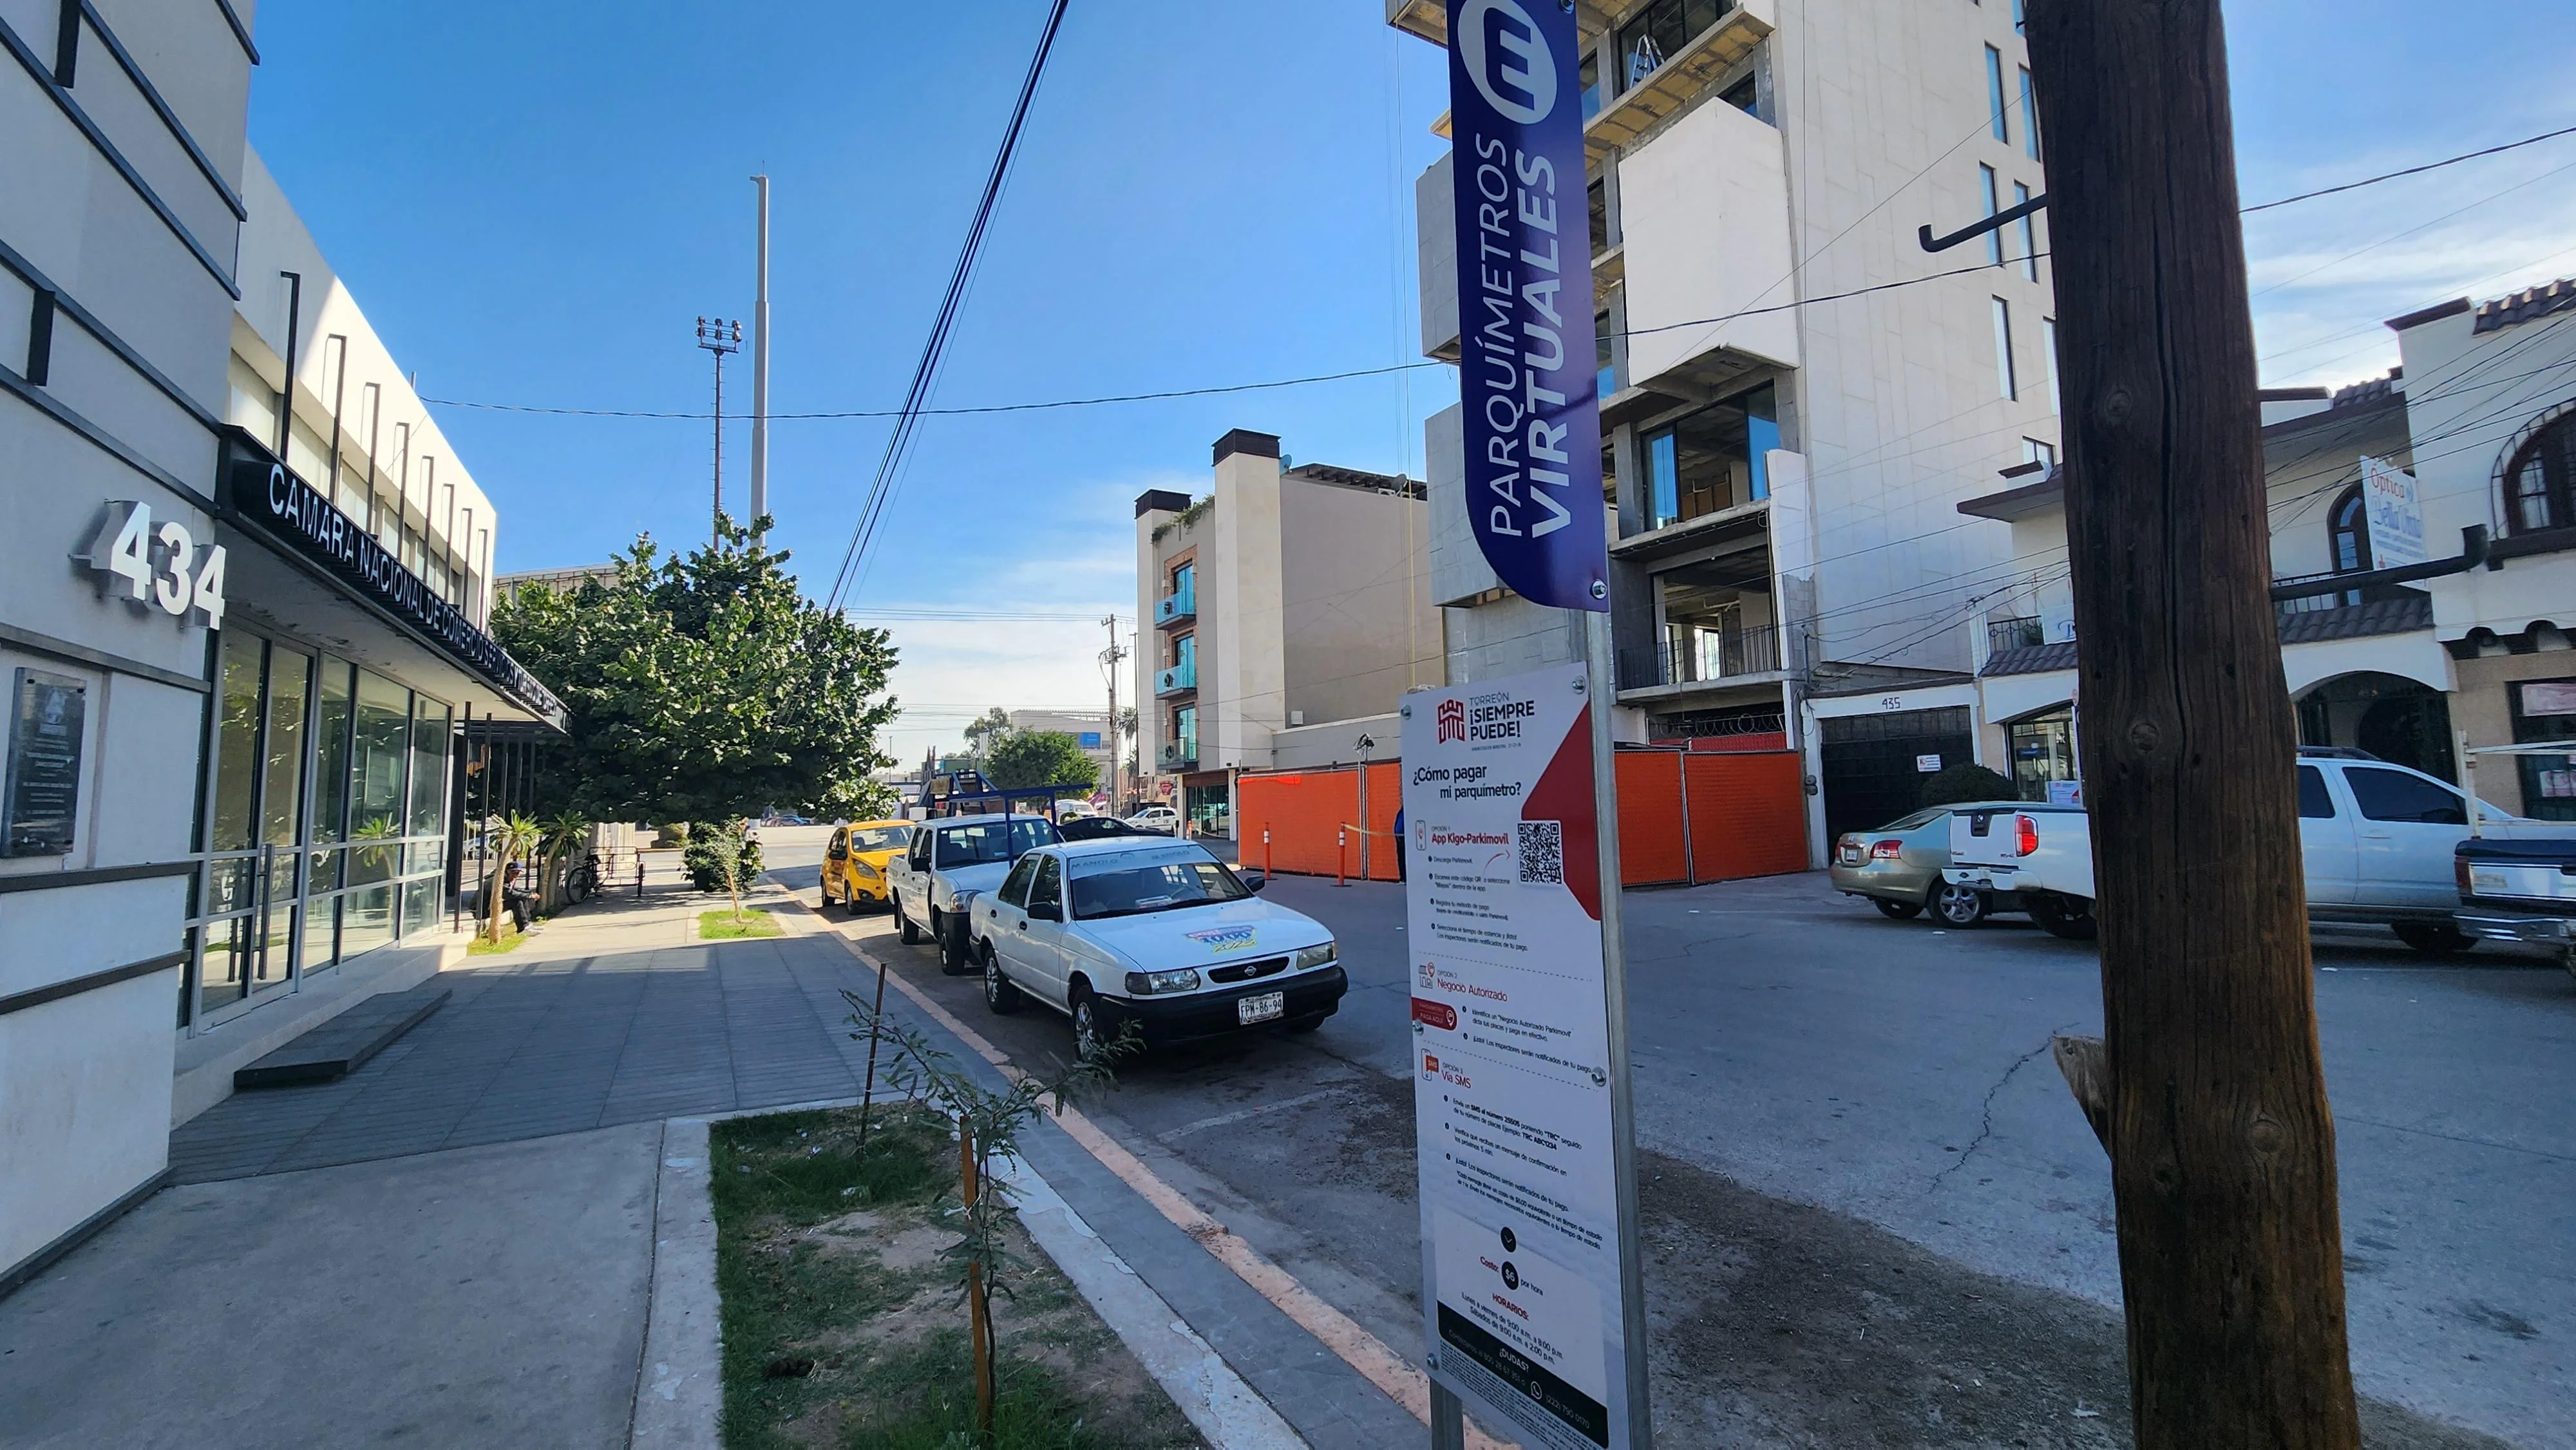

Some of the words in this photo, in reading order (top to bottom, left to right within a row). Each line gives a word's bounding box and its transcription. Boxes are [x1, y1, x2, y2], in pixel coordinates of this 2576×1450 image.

[1475, 133, 1524, 536] PARQUÍMETROS
[1515, 149, 1571, 538] VIRTUALES
[2371, 463, 2405, 499] Óptica
[110, 502, 225, 630] 434
[269, 464, 355, 567] CAMARA
[359, 535, 424, 619] NACIONAL
[426, 592, 440, 630] DE
[442, 605, 483, 661] COMERCIO
[1470, 692, 1510, 706] TORREÓN
[1882, 697, 1900, 710] 435
[1470, 701, 1535, 725] ¡SIEMPRE
[1470, 720, 1520, 740] PUEDE!
[1414, 766, 1450, 786] ¿Cómo
[1454, 766, 1487, 784] pagar
[1440, 786, 1451, 798] mi
[1455, 782, 1521, 801] parquímetro?
[1432, 833, 1446, 845] App
[1448, 833, 1510, 845] Kigo-Parkimovil
[1071, 859, 1118, 869] MANOLO
[1437, 978, 1466, 993] Negocio
[1468, 984, 1508, 1001] Autorizado
[1455, 1074, 1471, 1088] SMS
[1505, 1268, 1515, 1281] $6
[1531, 1283, 1543, 1295] hora
[1492, 1293, 1530, 1321] HORARIOS:
[1462, 1292, 1475, 1306] Lunes
[1481, 1305, 1498, 1319] viernes
[1507, 1319, 1519, 1332] 9:00
[1538, 1338, 1551, 1351] 8:00
[1470, 1306, 1491, 1324] Sábados
[1492, 1321, 1498, 1329] de
[1530, 1343, 1542, 1357] 2:00
